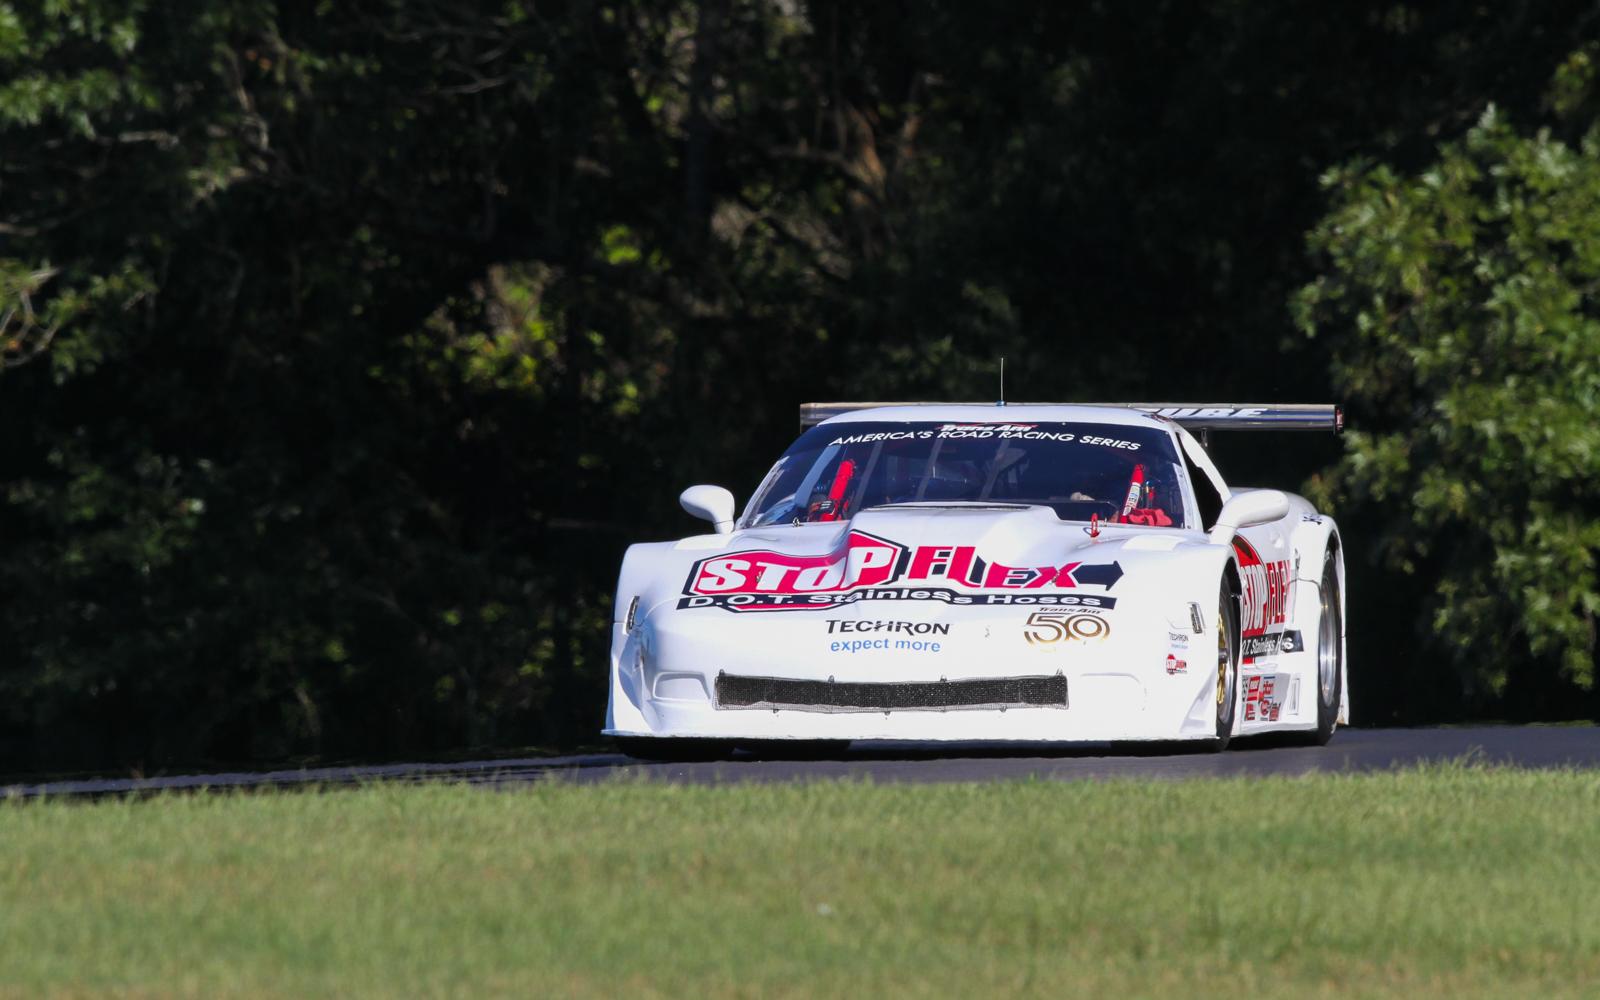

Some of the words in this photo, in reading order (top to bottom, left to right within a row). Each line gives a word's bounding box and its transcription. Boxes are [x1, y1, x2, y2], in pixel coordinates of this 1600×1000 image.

[829, 431, 933, 446] AMERICA'S
[938, 430, 993, 439] ROAD
[998, 431, 1075, 442] RACING
[1079, 436, 1141, 451] SERIES
[698, 547, 895, 591] STOP
[907, 546, 1083, 589] FLEX
[688, 595, 794, 608] D.O.T.
[807, 588, 973, 605] Stainless
[986, 594, 1102, 606] Hoses
[826, 620, 951, 636] TECHRON
[1023, 612, 1111, 645] 50
[830, 638, 889, 653] expect
[895, 639, 941, 652] more
